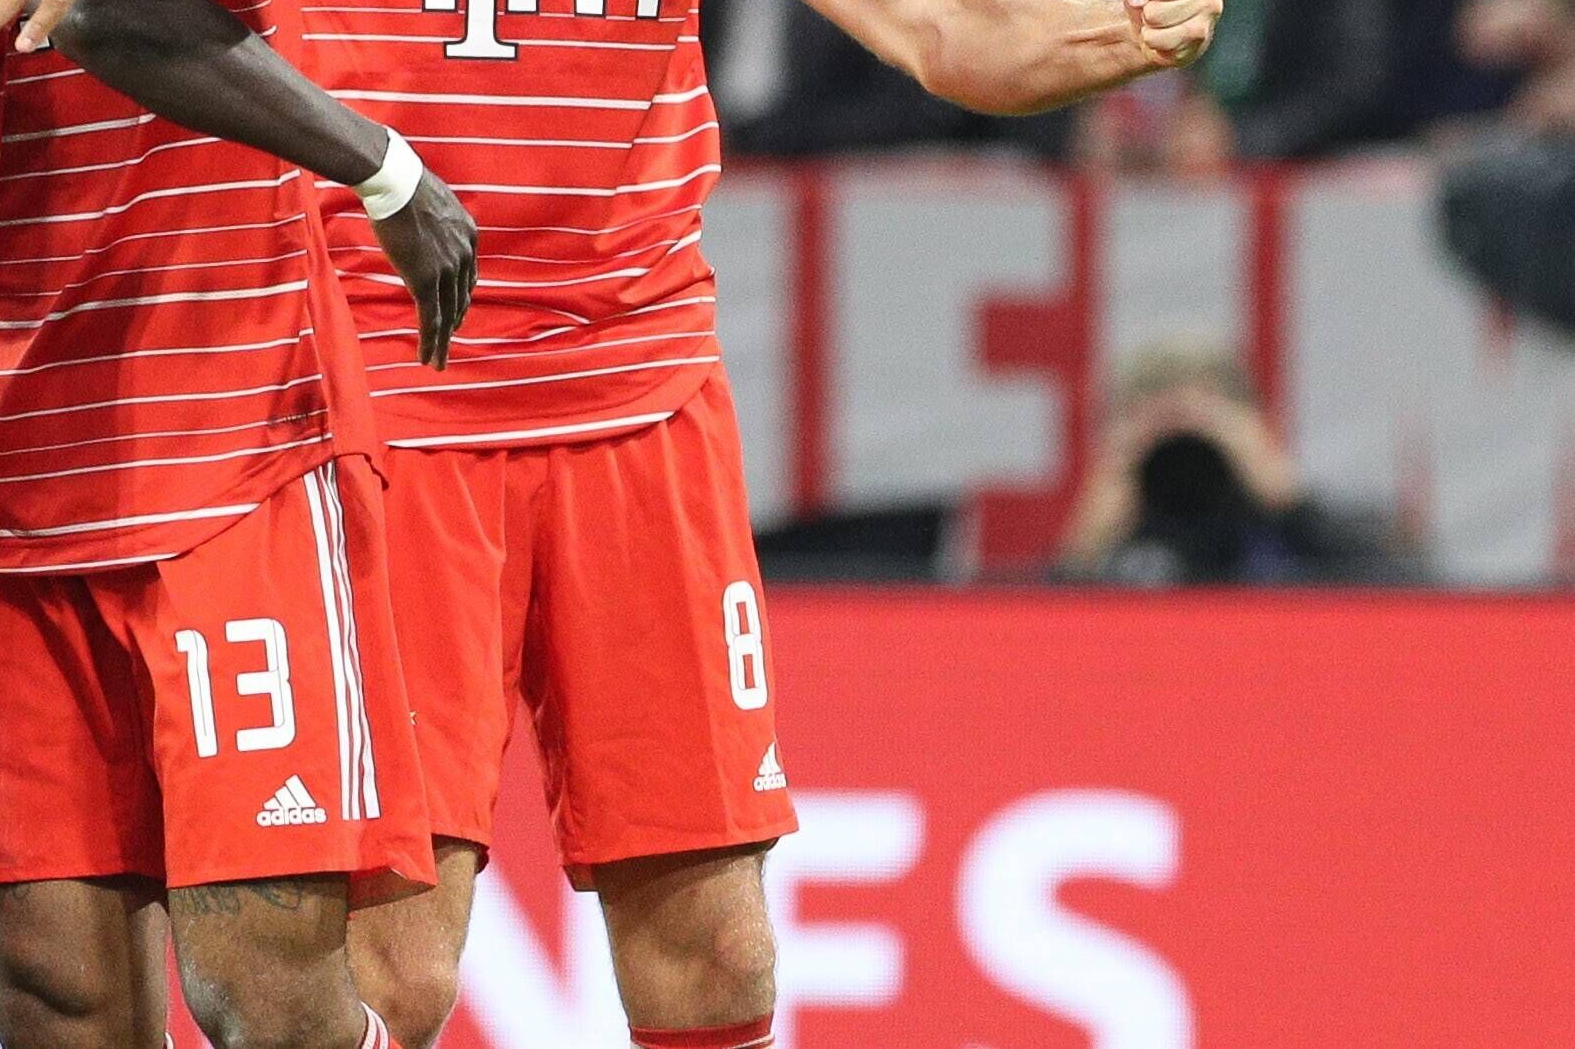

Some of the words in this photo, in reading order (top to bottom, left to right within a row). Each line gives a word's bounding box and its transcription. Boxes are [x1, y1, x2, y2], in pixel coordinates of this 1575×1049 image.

[175, 617, 297, 758] 13
[722, 580, 769, 710] 8
[256, 807, 328, 828] adidas
